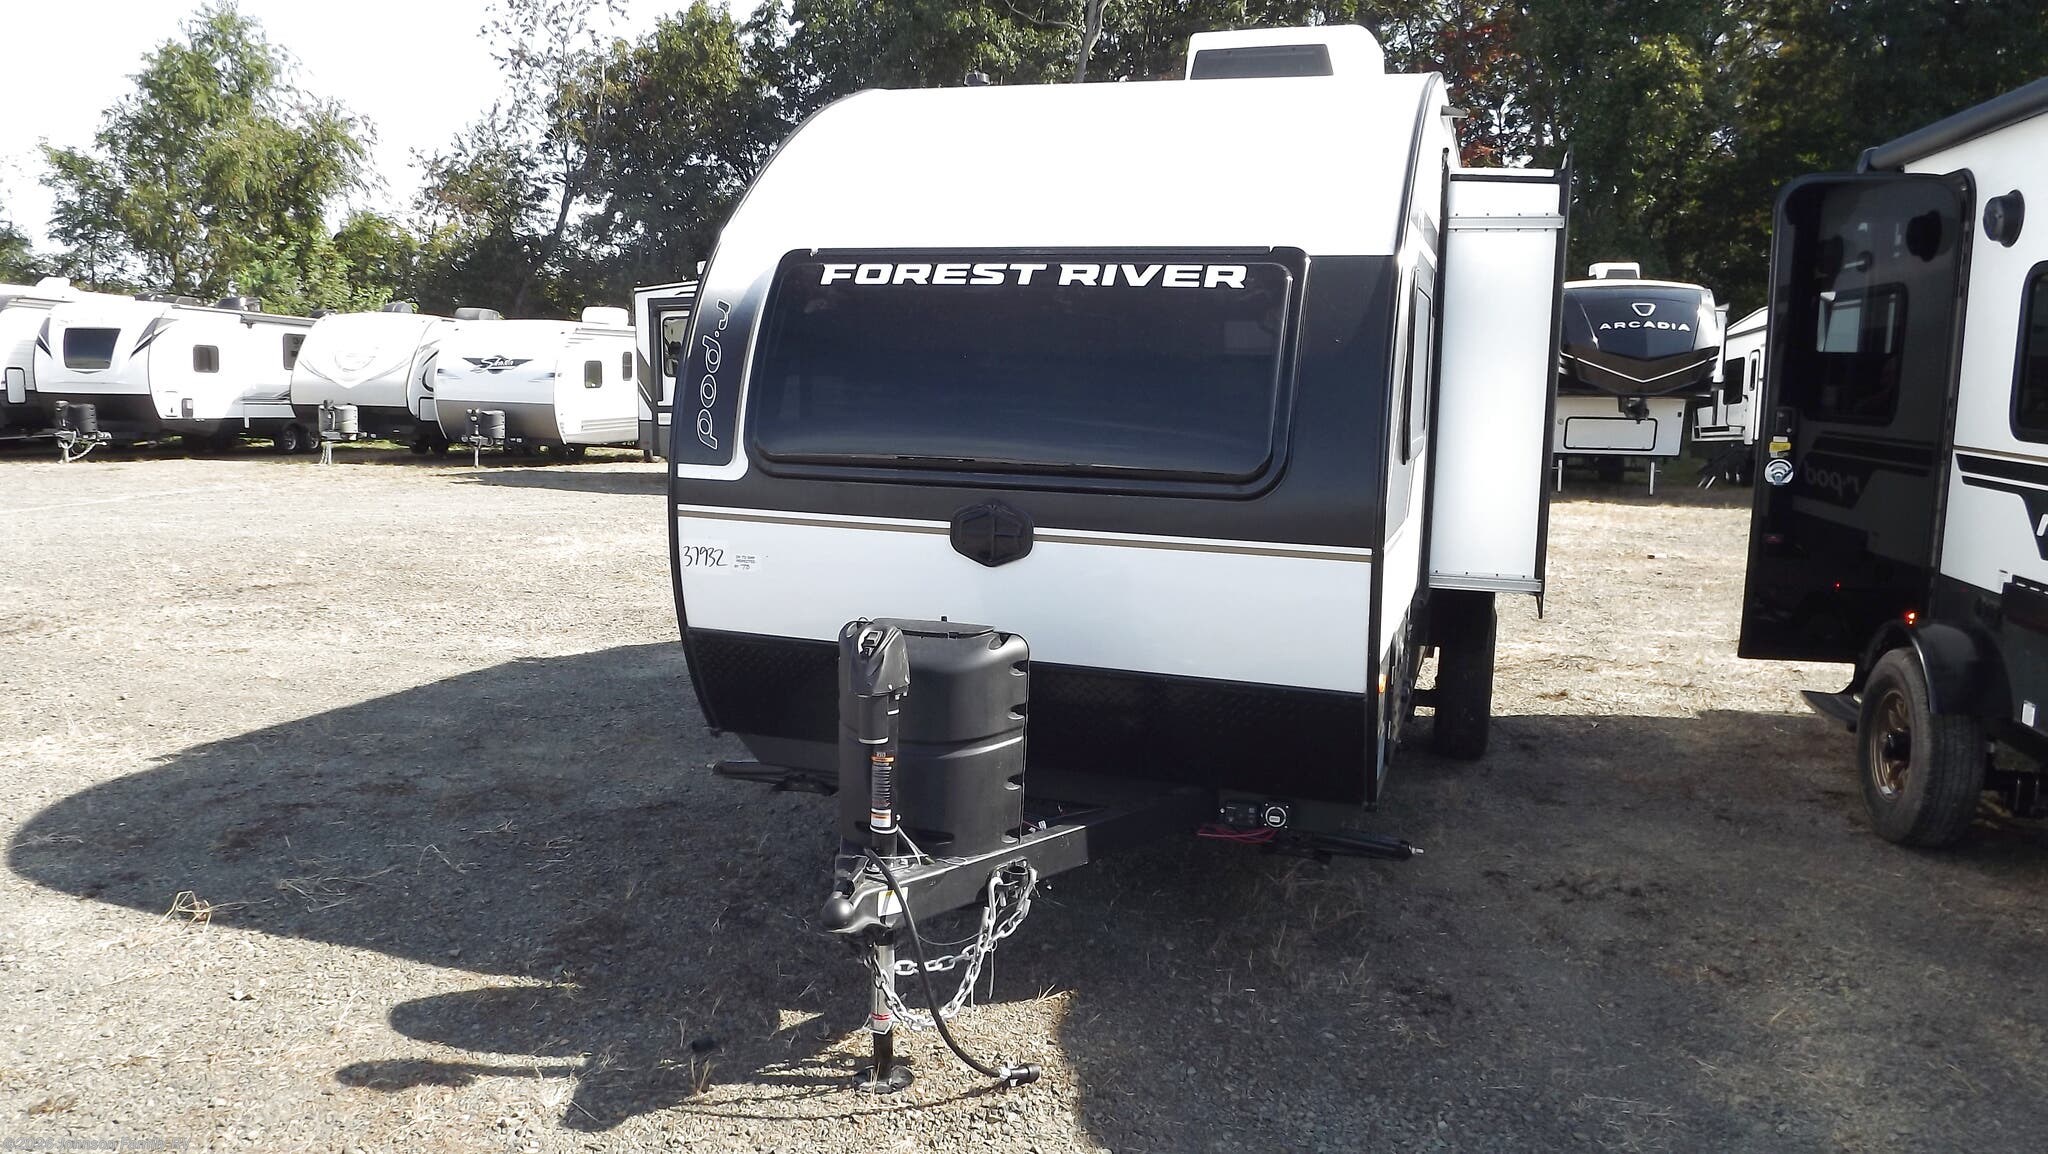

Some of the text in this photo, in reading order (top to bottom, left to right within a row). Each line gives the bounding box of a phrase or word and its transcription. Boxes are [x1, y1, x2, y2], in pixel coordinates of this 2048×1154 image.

[819, 263, 1248, 289] FOREST RIVER
[1599, 321, 1691, 332] ARCADIA
[683, 545, 728, 567] 37932
